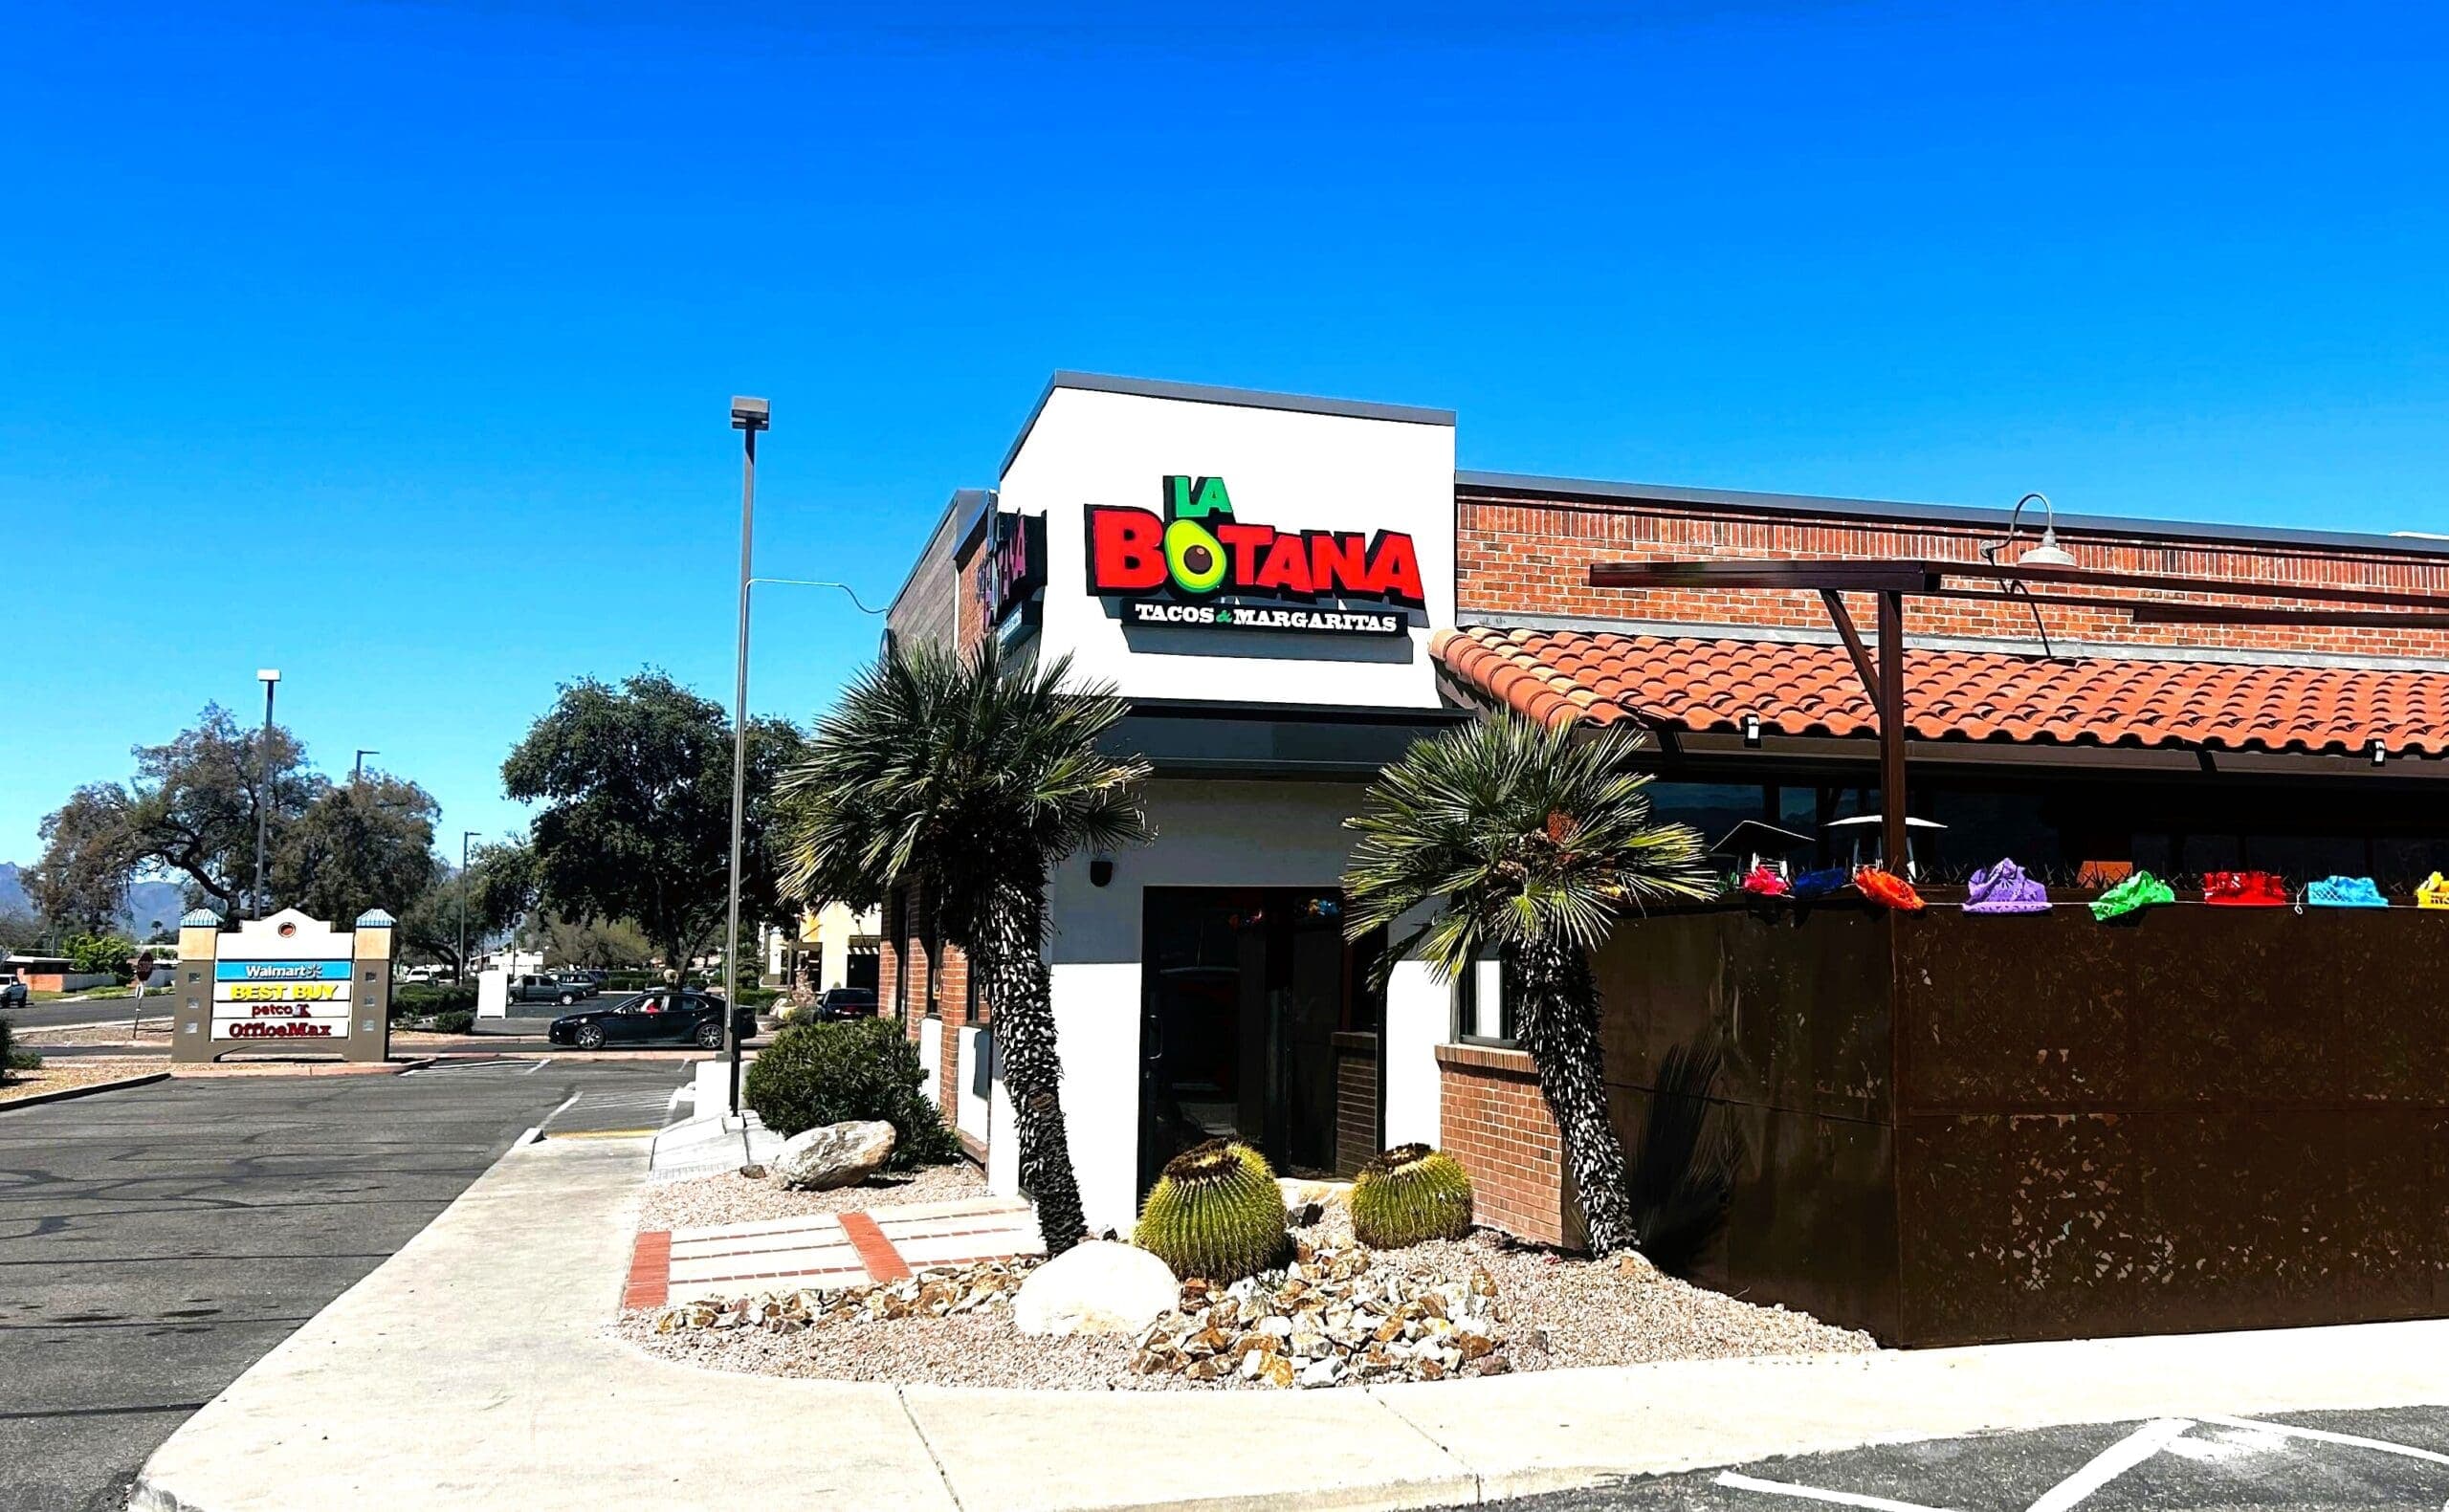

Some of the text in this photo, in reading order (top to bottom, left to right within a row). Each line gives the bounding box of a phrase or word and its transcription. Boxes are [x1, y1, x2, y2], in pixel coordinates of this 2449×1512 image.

[1169, 475, 1234, 517] LA
[1089, 506, 1425, 603] BOTANA
[1136, 603, 1215, 624] TACOS
[1233, 609, 1398, 632] MARGARITAS
[246, 966, 306, 978] Walmart
[231, 984, 338, 1000] BEST BUY
[252, 1004, 293, 1018] petco
[229, 1021, 332, 1038] OfficeMax
